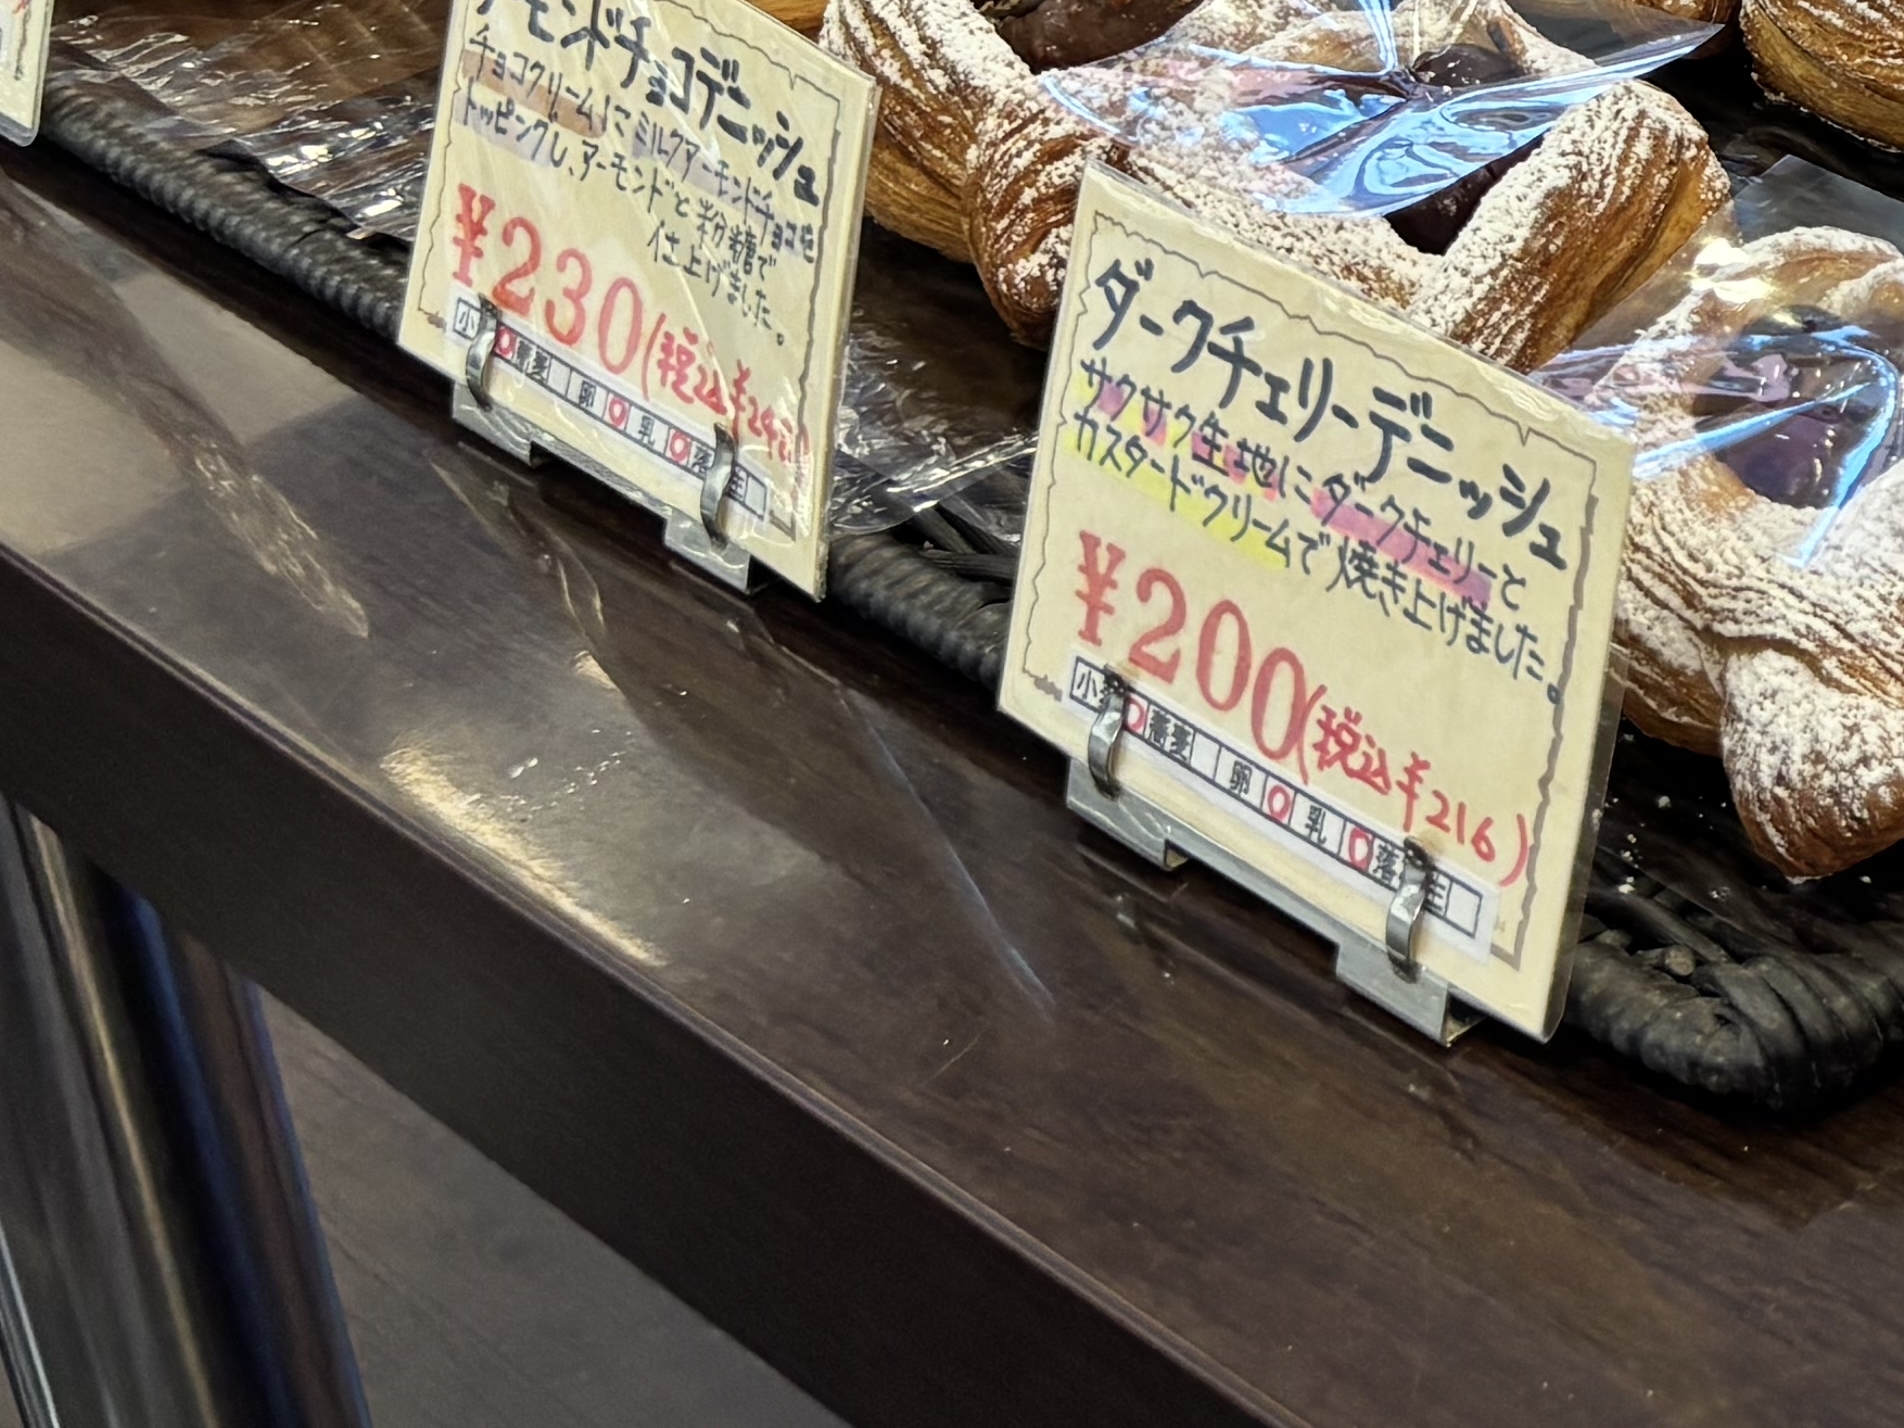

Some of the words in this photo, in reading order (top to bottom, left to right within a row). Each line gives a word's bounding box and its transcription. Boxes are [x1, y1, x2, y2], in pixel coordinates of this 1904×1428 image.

[1074, 406, 1562, 706] カスタードクリームで焼き上げました。
[1081, 358, 1527, 612] サクサク生地にダークチェリーと
[1093, 258, 1567, 570] ダークチェリーデニッシュ
